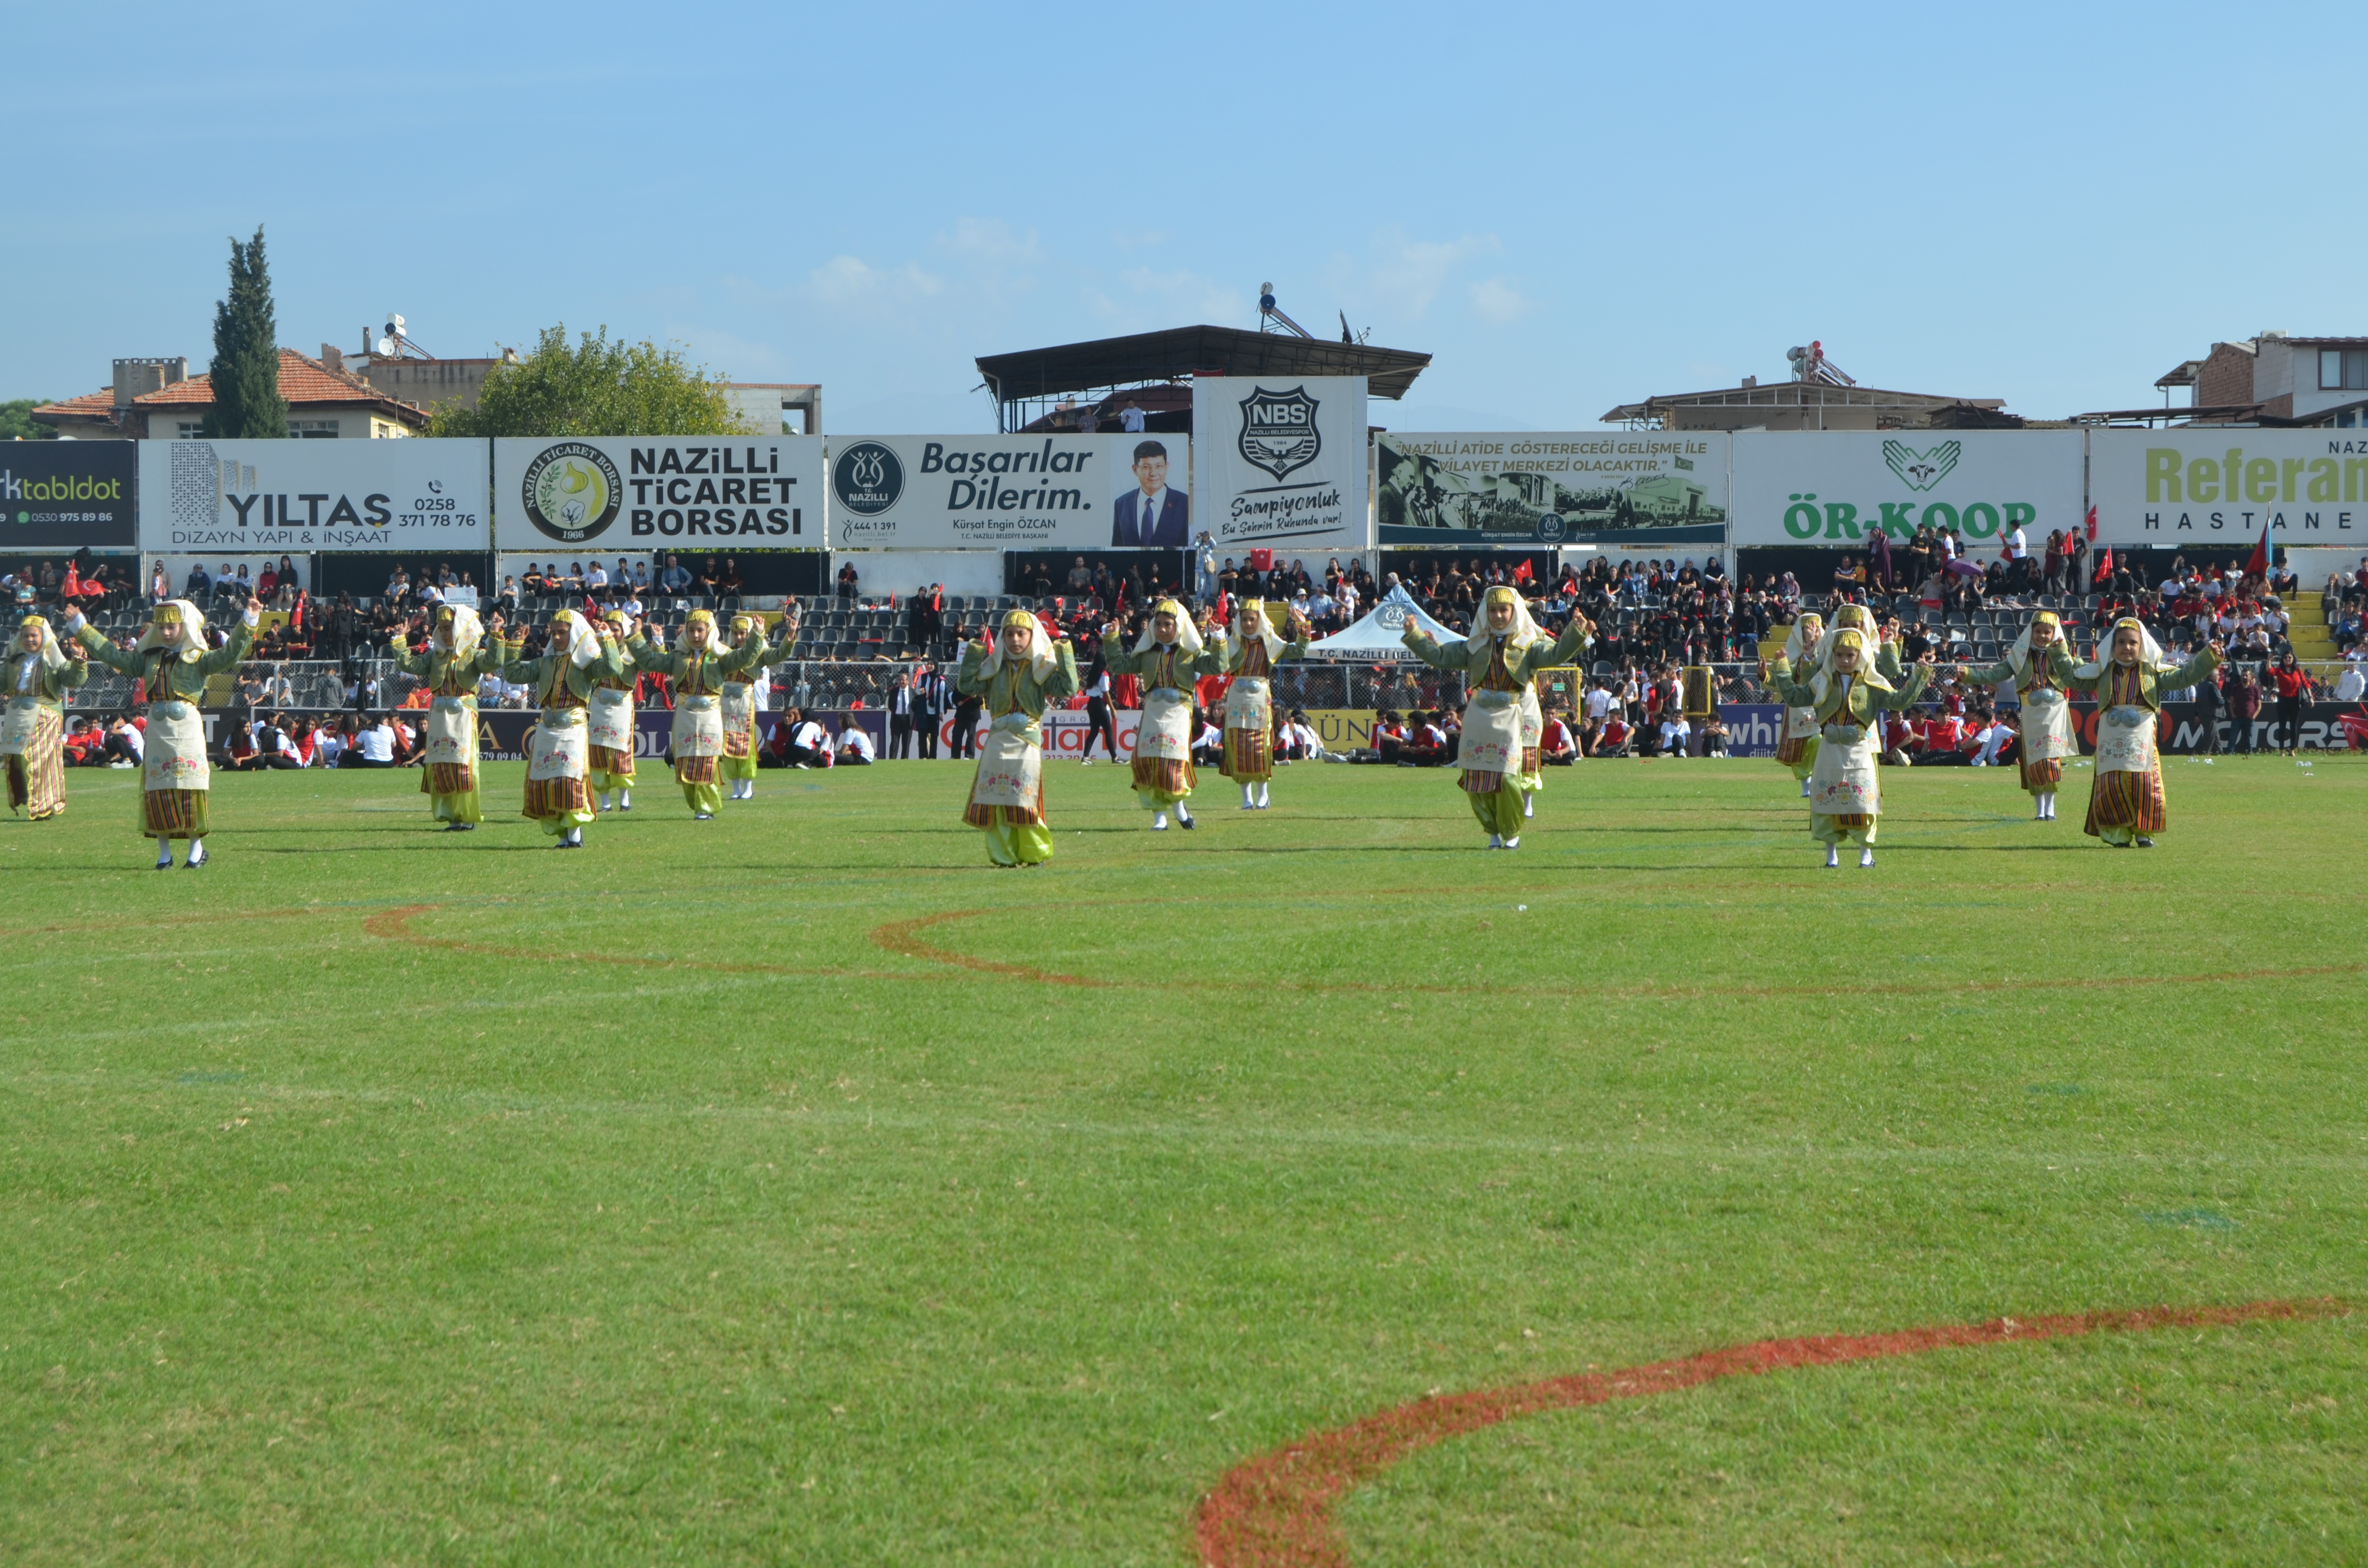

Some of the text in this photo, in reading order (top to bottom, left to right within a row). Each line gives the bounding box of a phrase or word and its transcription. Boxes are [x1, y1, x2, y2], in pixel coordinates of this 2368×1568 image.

[1253, 404, 1306, 424] NBS
[1511, 440, 1615, 454] GÖSTERECEĞİ
[1617, 440, 1681, 457] GELİŞME
[1685, 440, 1707, 454] İLE
[920, 438, 1093, 480] Başarılar
[1503, 457, 1569, 471] MERKEZİ
[596, 455, 620, 508] BORSASI
[947, 476, 1091, 510] Dilerim.
[415, 499, 455, 510] 0258
[1231, 489, 1342, 522] Şampiyonluk
[32, 513, 113, 522] 0530 975 89 86
[399, 514, 476, 527] 371 78 76
[631, 508, 801, 536] BORSASI
[953, 516, 1056, 531] Kürşat Engin ÖZCAN
[1221, 512, 1342, 535] Bu Şehrin Ruhunda var!
[1784, 493, 2036, 539] ÖR-KOOP
[2146, 512, 2351, 529] HASTANE
[253, 531, 292, 543] YAPI
[301, 531, 314, 543] &
[562, 530, 585, 539] 1966
[973, 531, 994, 539] NAZİLLİ
[996, 531, 1021, 539] BELEDİYE
[1318, 649, 1420, 660] T.C. NAZİLLİ BELE
[1722, 713, 1782, 745] whi
